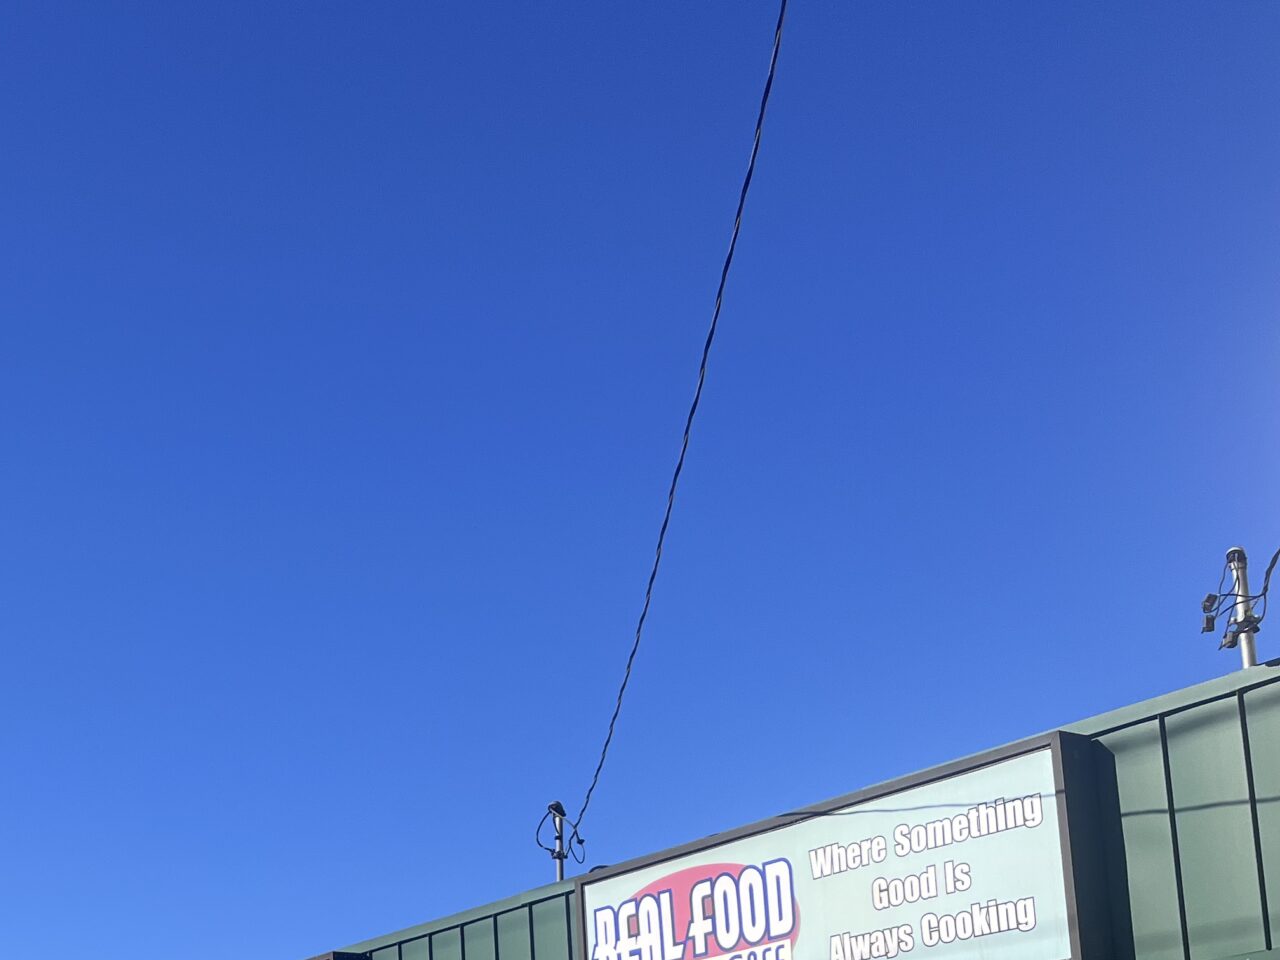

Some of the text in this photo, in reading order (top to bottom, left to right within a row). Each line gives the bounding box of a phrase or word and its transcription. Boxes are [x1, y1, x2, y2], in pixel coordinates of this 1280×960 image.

[809, 792, 1043, 880] Where Something
[683, 858, 796, 958] FOOD
[871, 861, 972, 911] Good Is
[921, 897, 1037, 947] Cooking
